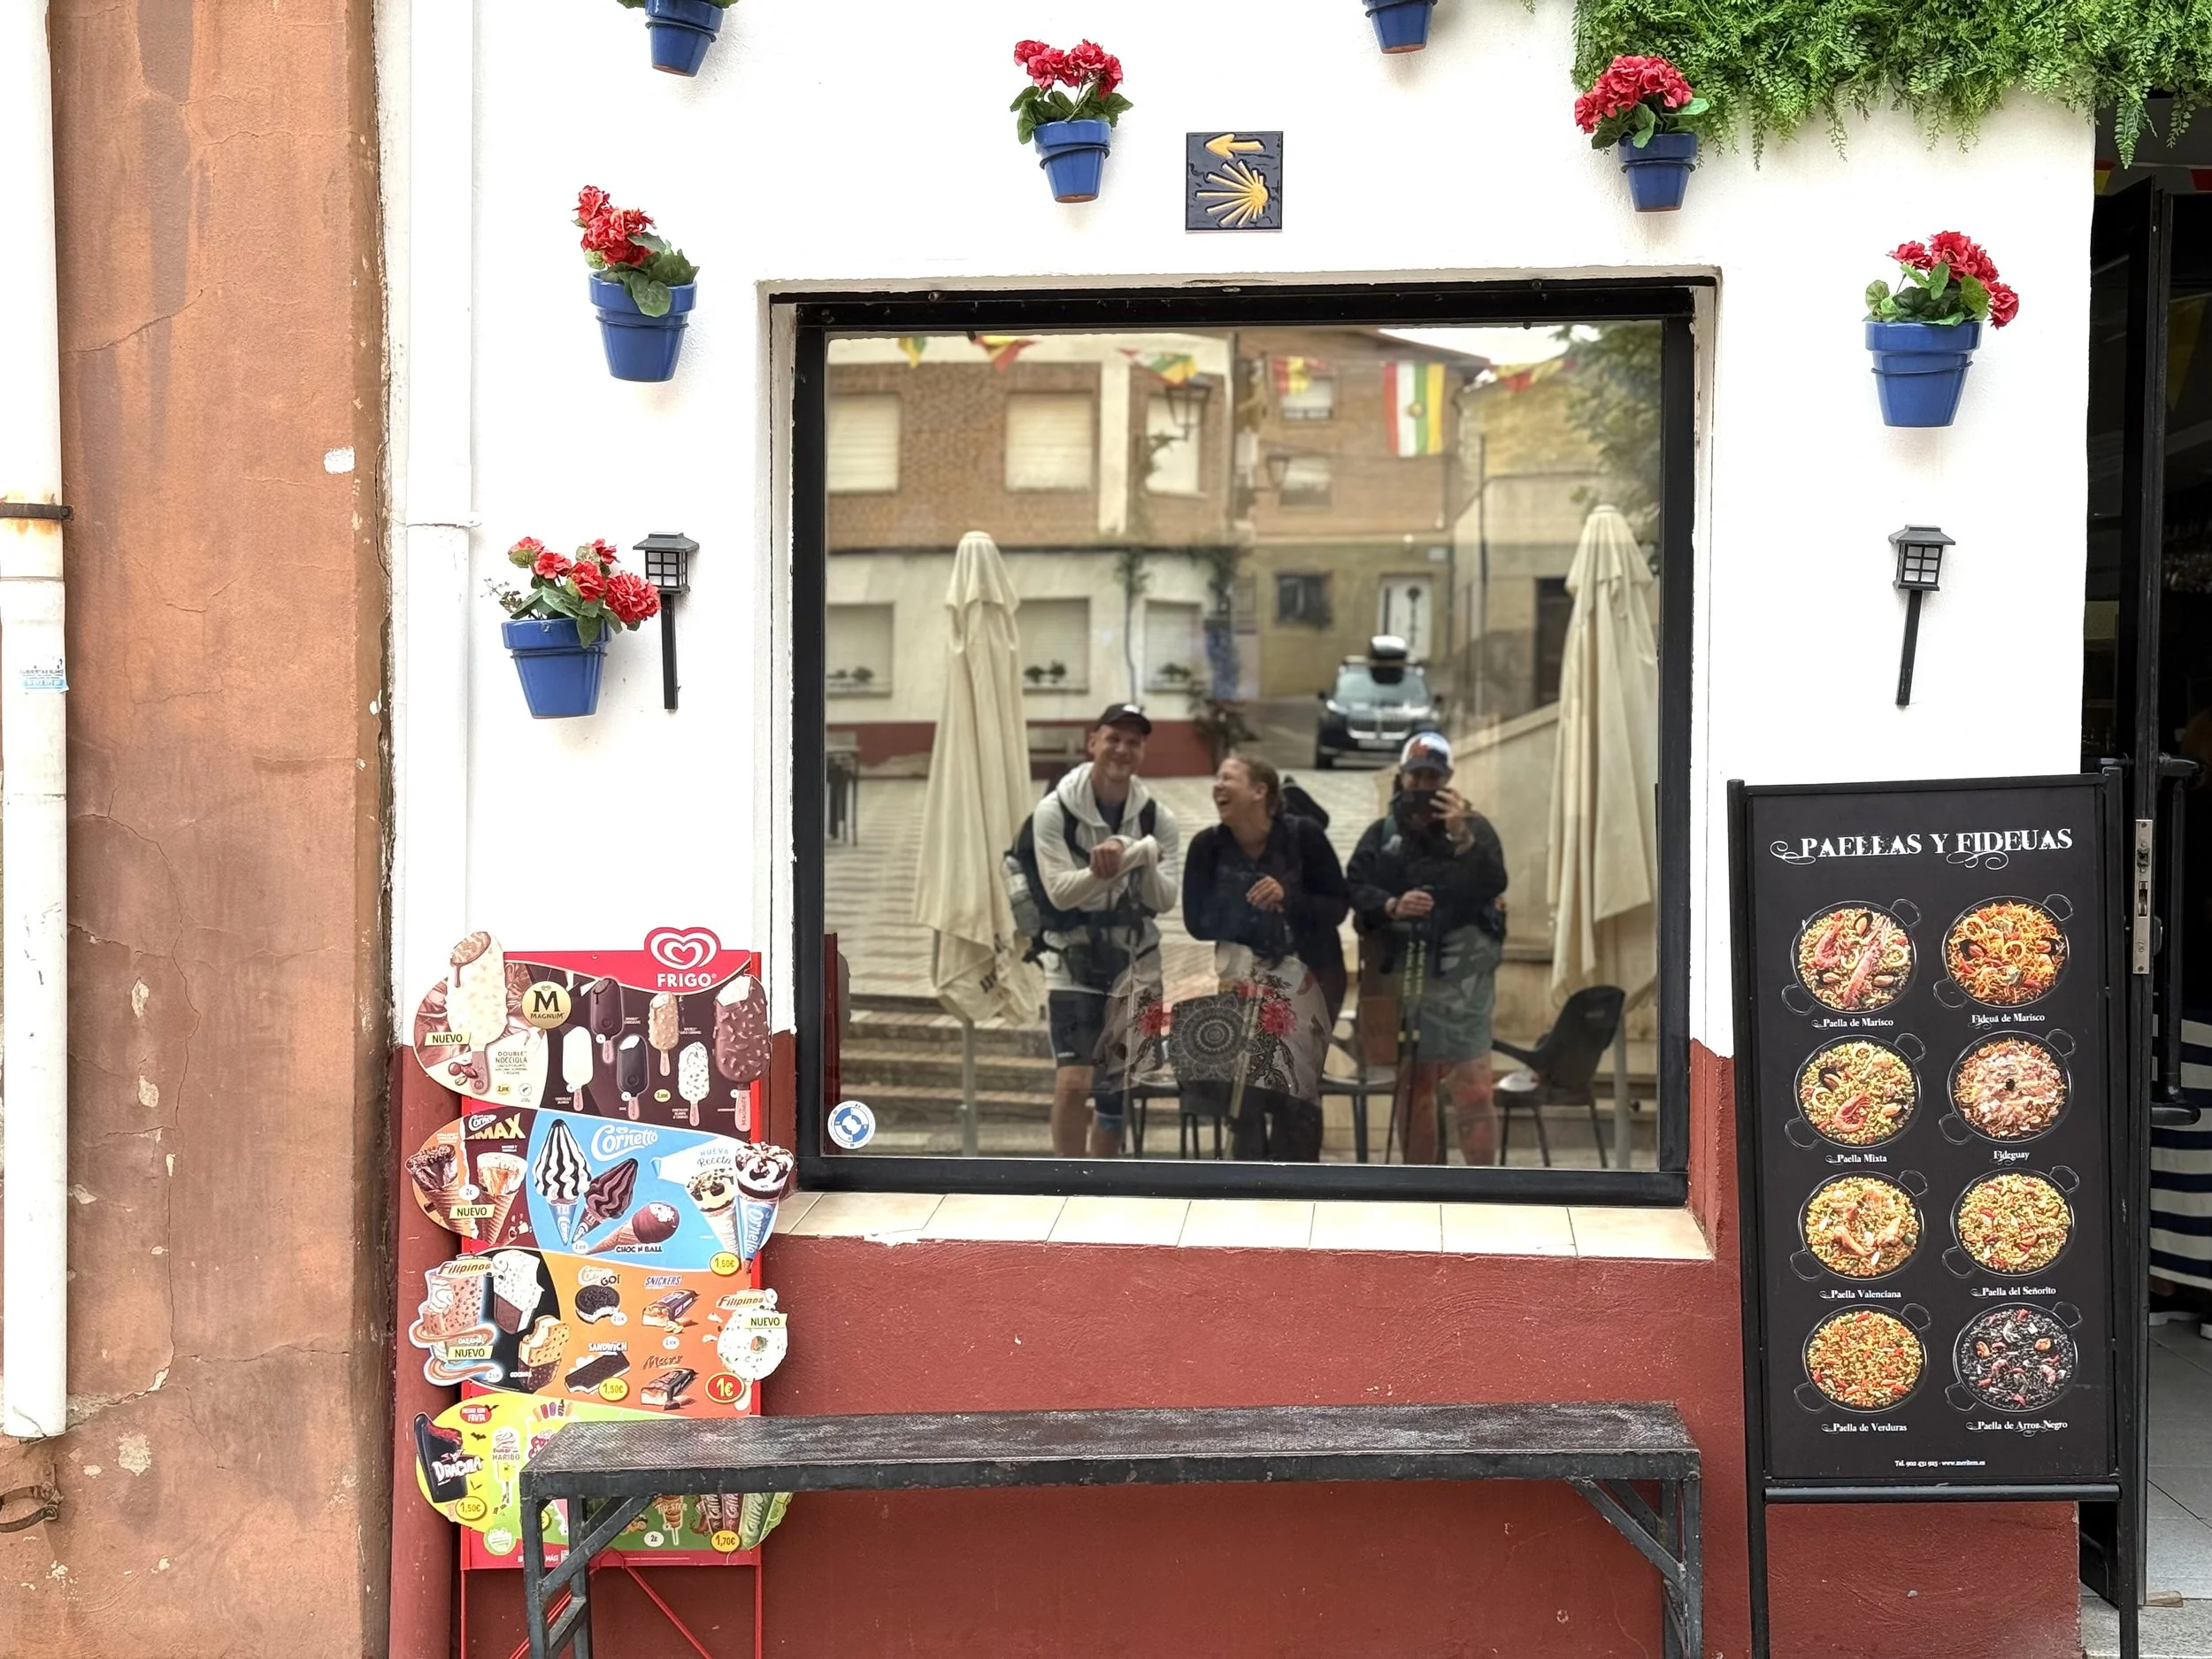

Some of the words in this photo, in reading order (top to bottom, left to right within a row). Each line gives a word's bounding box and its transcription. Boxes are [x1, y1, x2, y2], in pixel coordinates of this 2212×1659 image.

[1778, 833, 1923, 862] PAELLAS
[1929, 833, 1949, 854] Y
[1951, 828, 2073, 860] FIDEUAS
[657, 972, 712, 987] FRIGO
[530, 1011, 565, 1020] MAGNUM
[2001, 1014, 2011, 1023] de
[2013, 1013, 2045, 1022] Marisco
[1817, 1018, 1847, 1028] Paella
[1849, 1018, 1860, 1027] de
[1862, 1018, 1893, 1027] Marisco
[432, 1033, 464, 1044] NUEVO
[474, 1112, 526, 1140] MAX
[590, 1124, 658, 1162] Cornetto
[697, 1156, 732, 1168] Receta
[1832, 1154, 1862, 1164] Paella
[1863, 1153, 1887, 1163] Mixta
[1992, 1150, 2030, 1163] Fideguay
[457, 1207, 488, 1217] NUEVO
[437, 1262, 491, 1275] Filipinos
[714, 1257, 735, 1270] 1,50€
[645, 1276, 681, 1286] SNICKERS
[1826, 1289, 1855, 1300] Paella
[1856, 1289, 1901, 1299] Valenciana
[1977, 1287, 2007, 1298] Paella
[2008, 1286, 2021, 1296] del
[2022, 1286, 2057, 1295] Señorito
[718, 1295, 764, 1307] Filipinos
[749, 1317, 780, 1327] NUEVO
[454, 1348, 486, 1358] NUEVO
[603, 1383, 624, 1394] 1,50€
[716, 1377, 734, 1398] 1€
[1828, 1423, 1857, 1432] Paella
[1859, 1423, 1869, 1432] de
[1870, 1422, 1908, 1432] Verduras
[1973, 1421, 2002, 1431] Paella
[2004, 1421, 2015, 1430] de
[2016, 1420, 2040, 1432] Arroz
[2042, 1419, 2068, 1432] Negro
[431, 1455, 484, 1483] DRACULA
[459, 1504, 481, 1513] 1,50€
[715, 1536, 736, 1548] 1,70€
